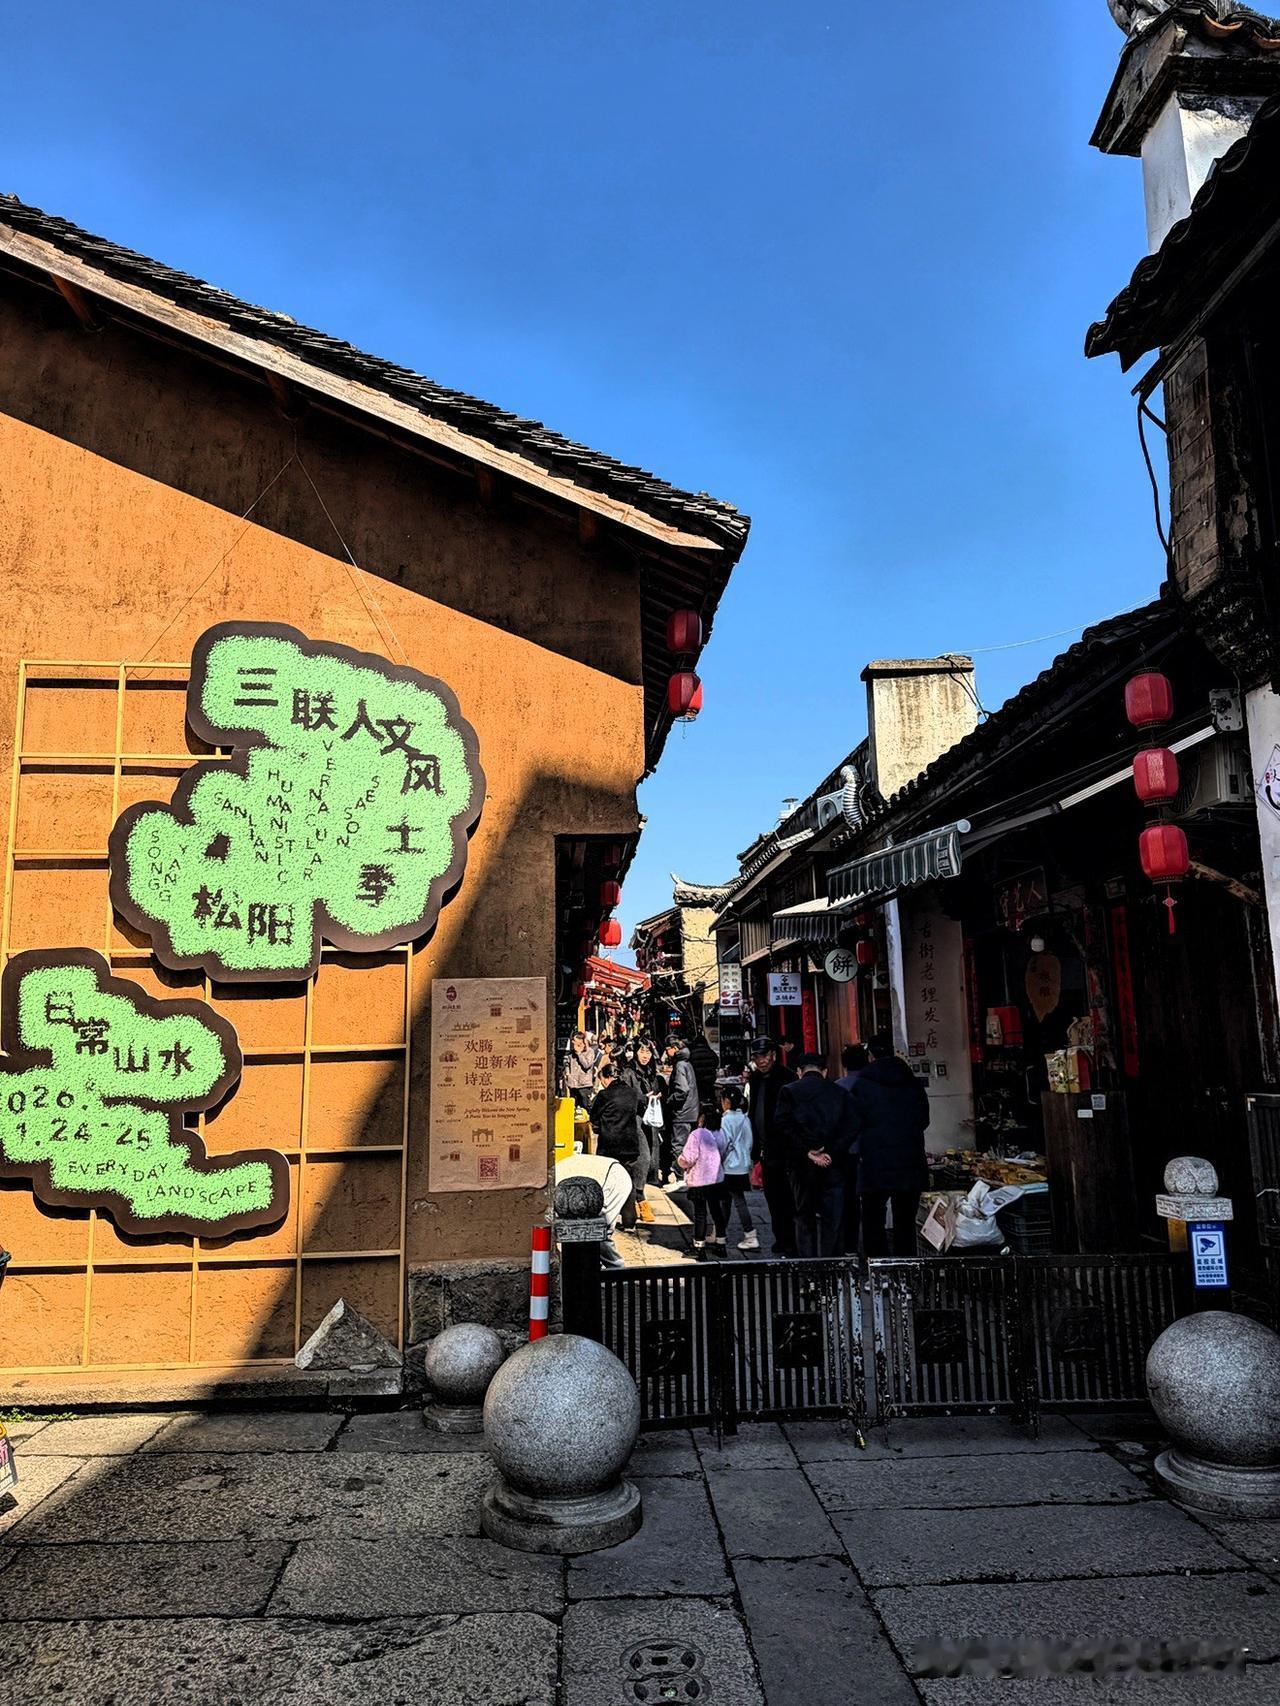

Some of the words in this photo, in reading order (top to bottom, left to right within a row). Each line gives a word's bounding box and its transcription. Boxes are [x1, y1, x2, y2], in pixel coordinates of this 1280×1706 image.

[192, 884, 295, 945] 松阳
[45, 991, 195, 1080] 日常山水
[464, 1039, 493, 1053] 欢腾
[475, 1055, 518, 1069] 迎新春
[464, 1072, 493, 1086] 诗意
[480, 1088, 522, 1102] 松阳年
[147, 1180, 258, 1205] LANDSCAPE
